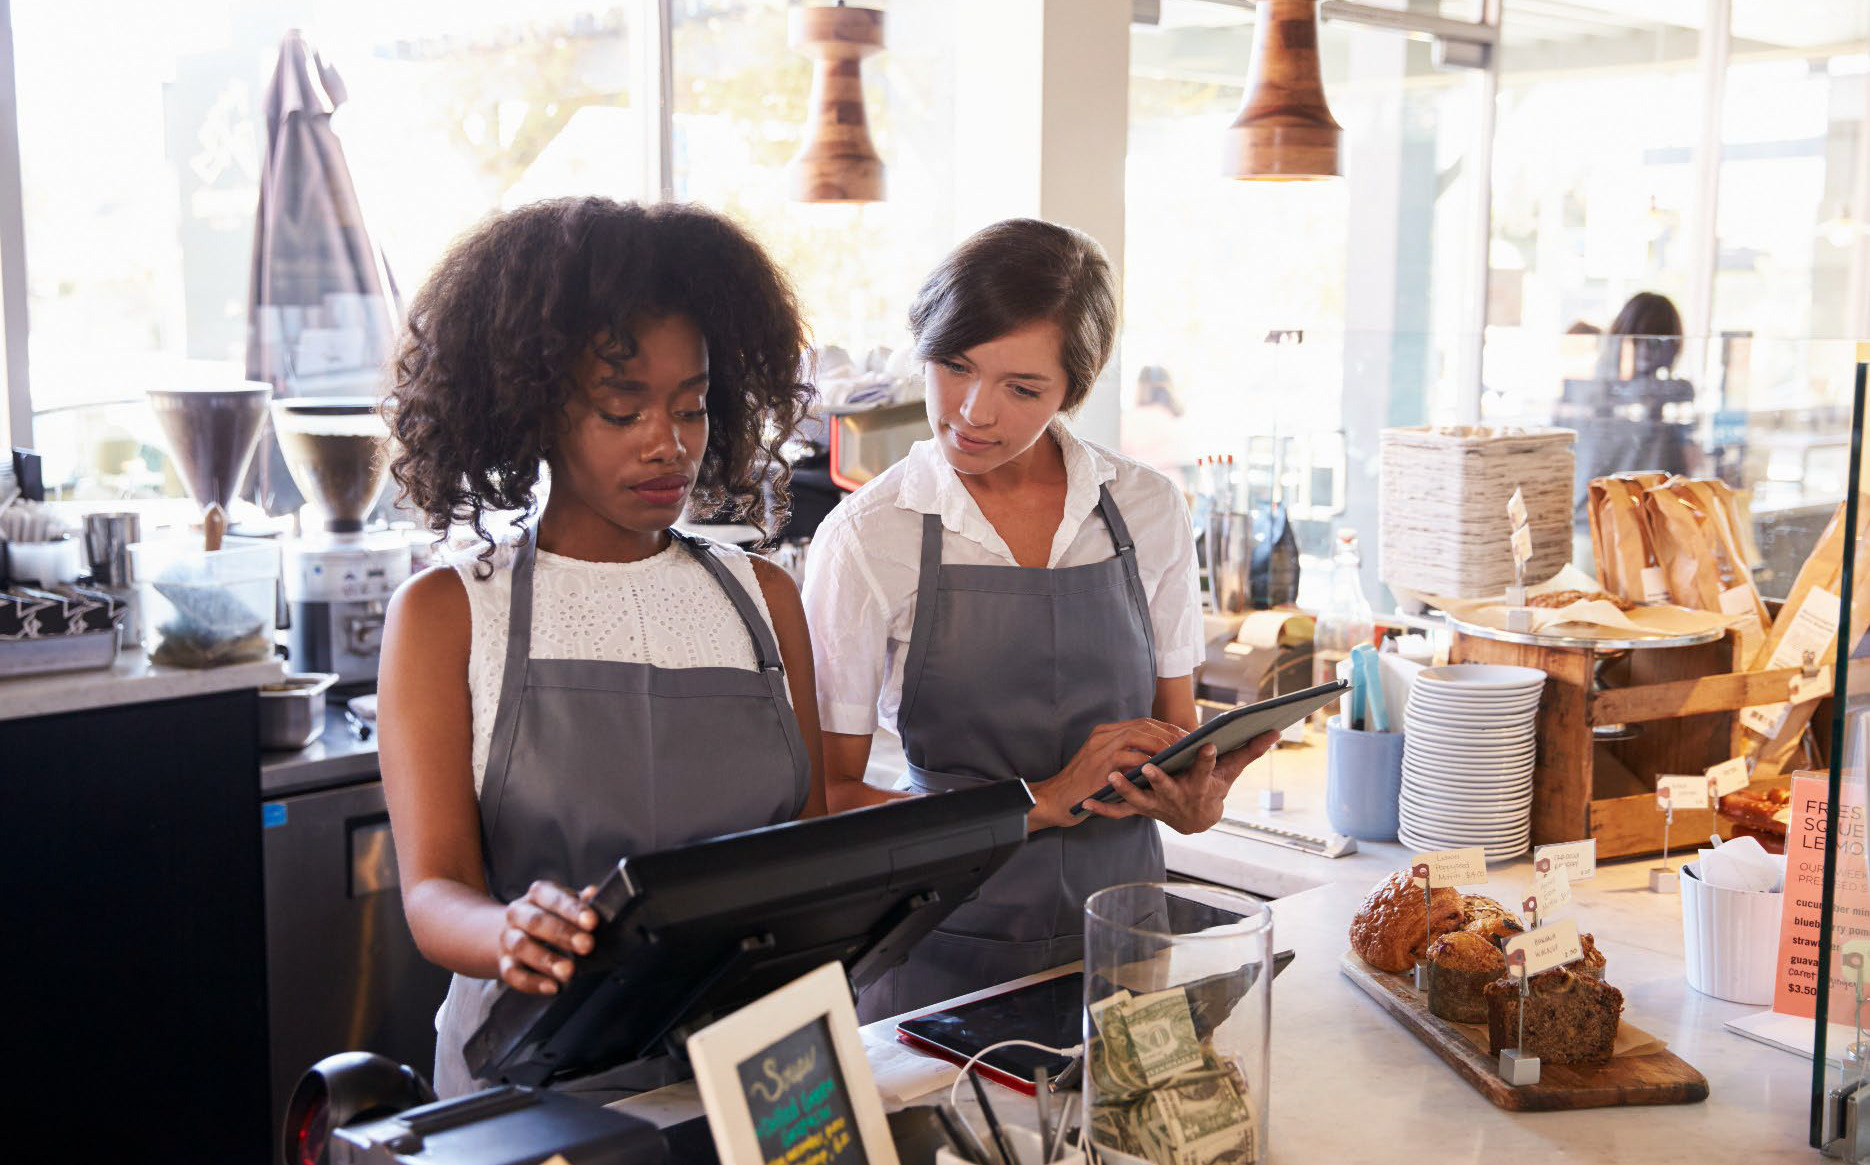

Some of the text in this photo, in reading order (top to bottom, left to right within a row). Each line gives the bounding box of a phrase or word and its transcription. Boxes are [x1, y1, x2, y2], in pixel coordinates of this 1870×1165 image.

[1796, 899, 1849, 914] cucuber
[1794, 917, 1846, 935] bluebrry
[1790, 955, 1819, 967] guava
[1787, 983, 1817, 996] $3.50
